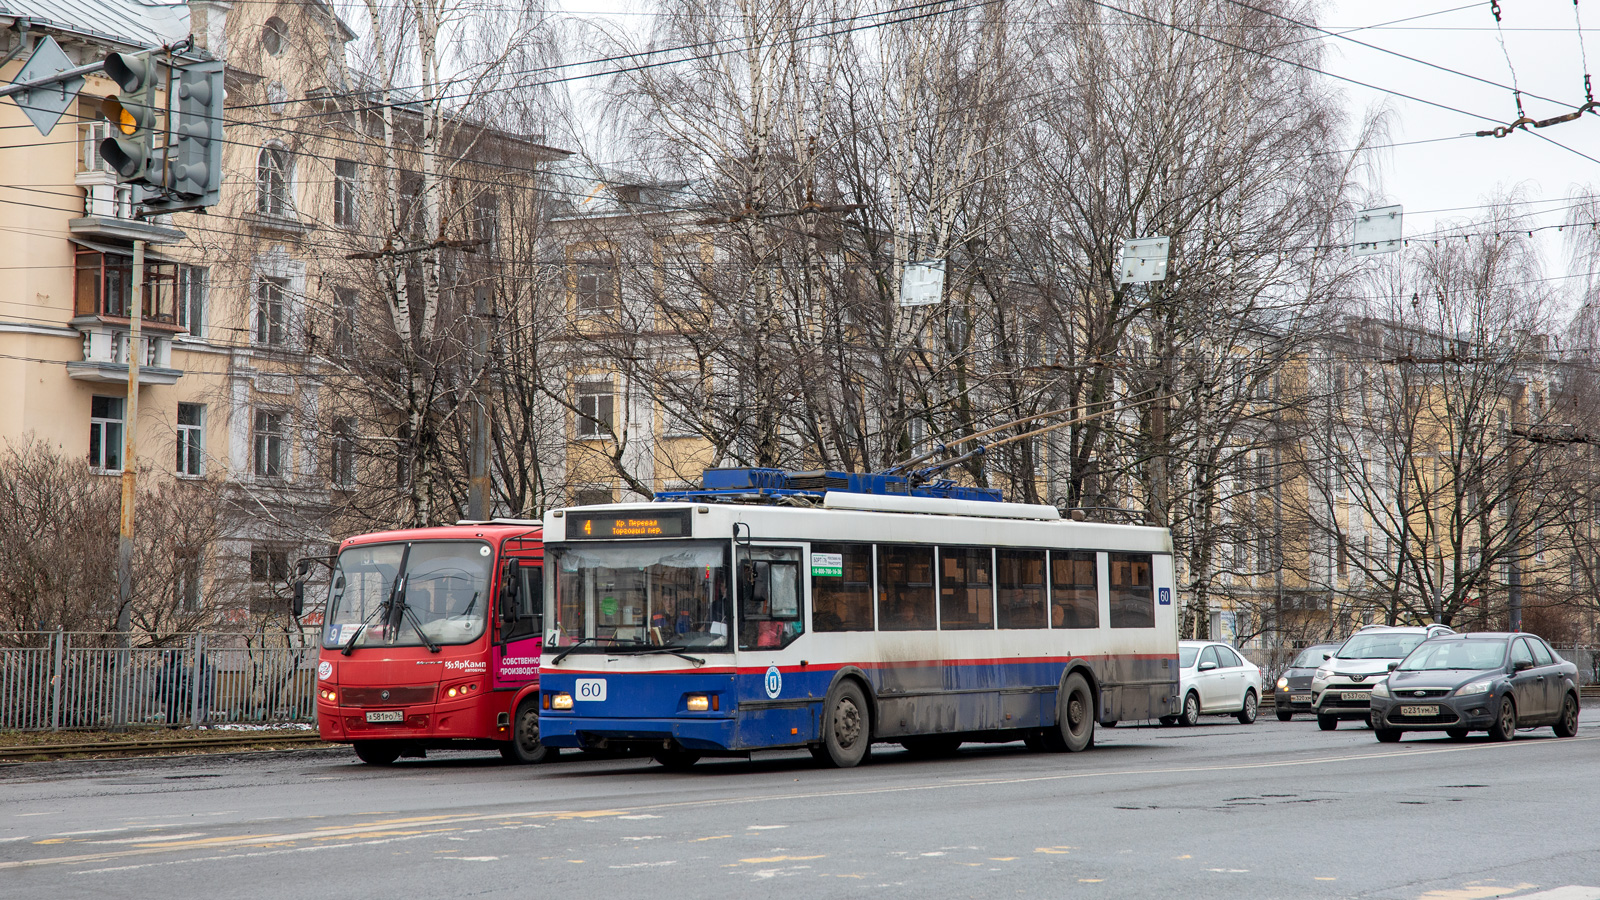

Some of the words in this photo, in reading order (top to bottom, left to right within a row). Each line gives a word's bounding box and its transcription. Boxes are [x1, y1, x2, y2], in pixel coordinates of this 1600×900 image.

[584, 520, 591, 534] 4
[629, 519, 657, 527] Перевал
[612, 527, 645, 535] Торговый
[1160, 590, 1169, 602] 60
[330, 628, 338, 641] 9
[548, 633, 556, 647] 4
[502, 656, 541, 665] СОБСТВЕННО
[581, 682, 601, 697] 60
